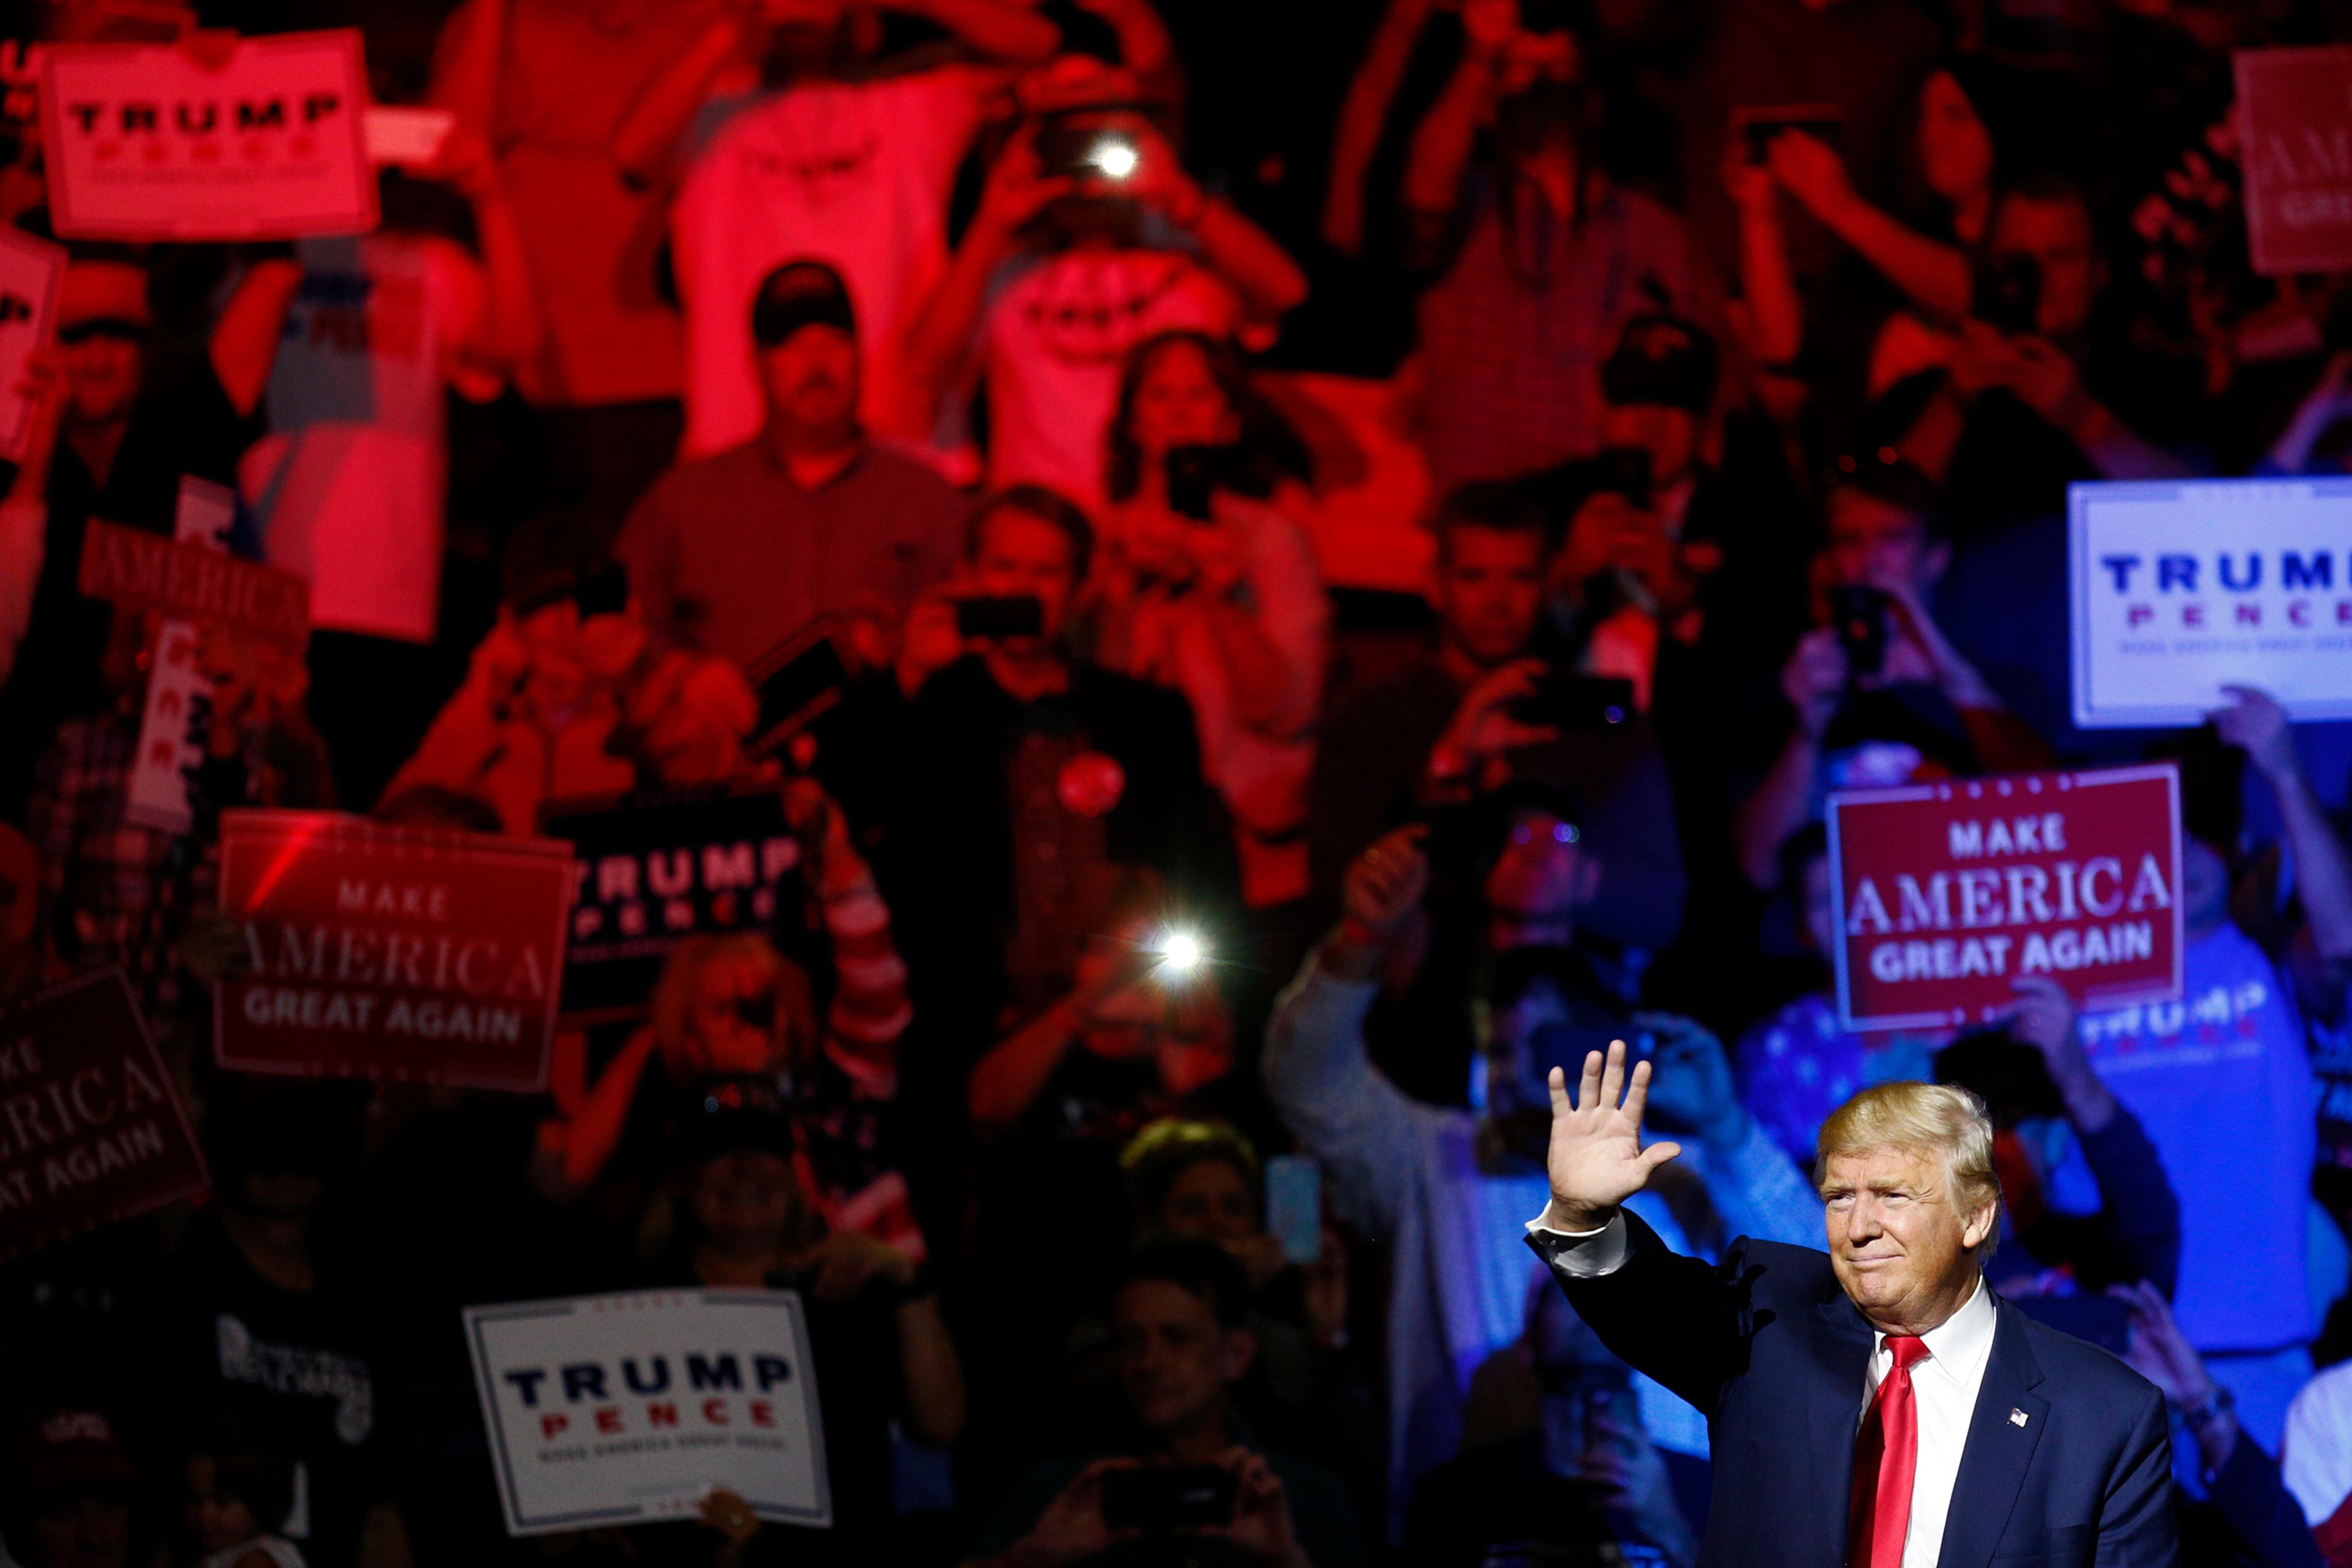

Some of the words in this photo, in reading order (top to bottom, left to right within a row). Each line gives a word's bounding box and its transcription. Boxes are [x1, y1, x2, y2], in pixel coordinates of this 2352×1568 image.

[70, 93, 341, 135] TRUMP
[1948, 812, 2067, 859] MAKE
[337, 875, 451, 920] MAKE
[1847, 851, 2171, 936] AMERICA
[1869, 935, 2013, 984] GREAT
[2022, 920, 2154, 975] AGAIN
[244, 986, 376, 1031] GREAT
[385, 997, 524, 1042] AGAIN
[43, 1120, 165, 1196] AGAIN
[505, 1354, 791, 1408] TRUMP
[540, 1400, 775, 1439] PENCE
